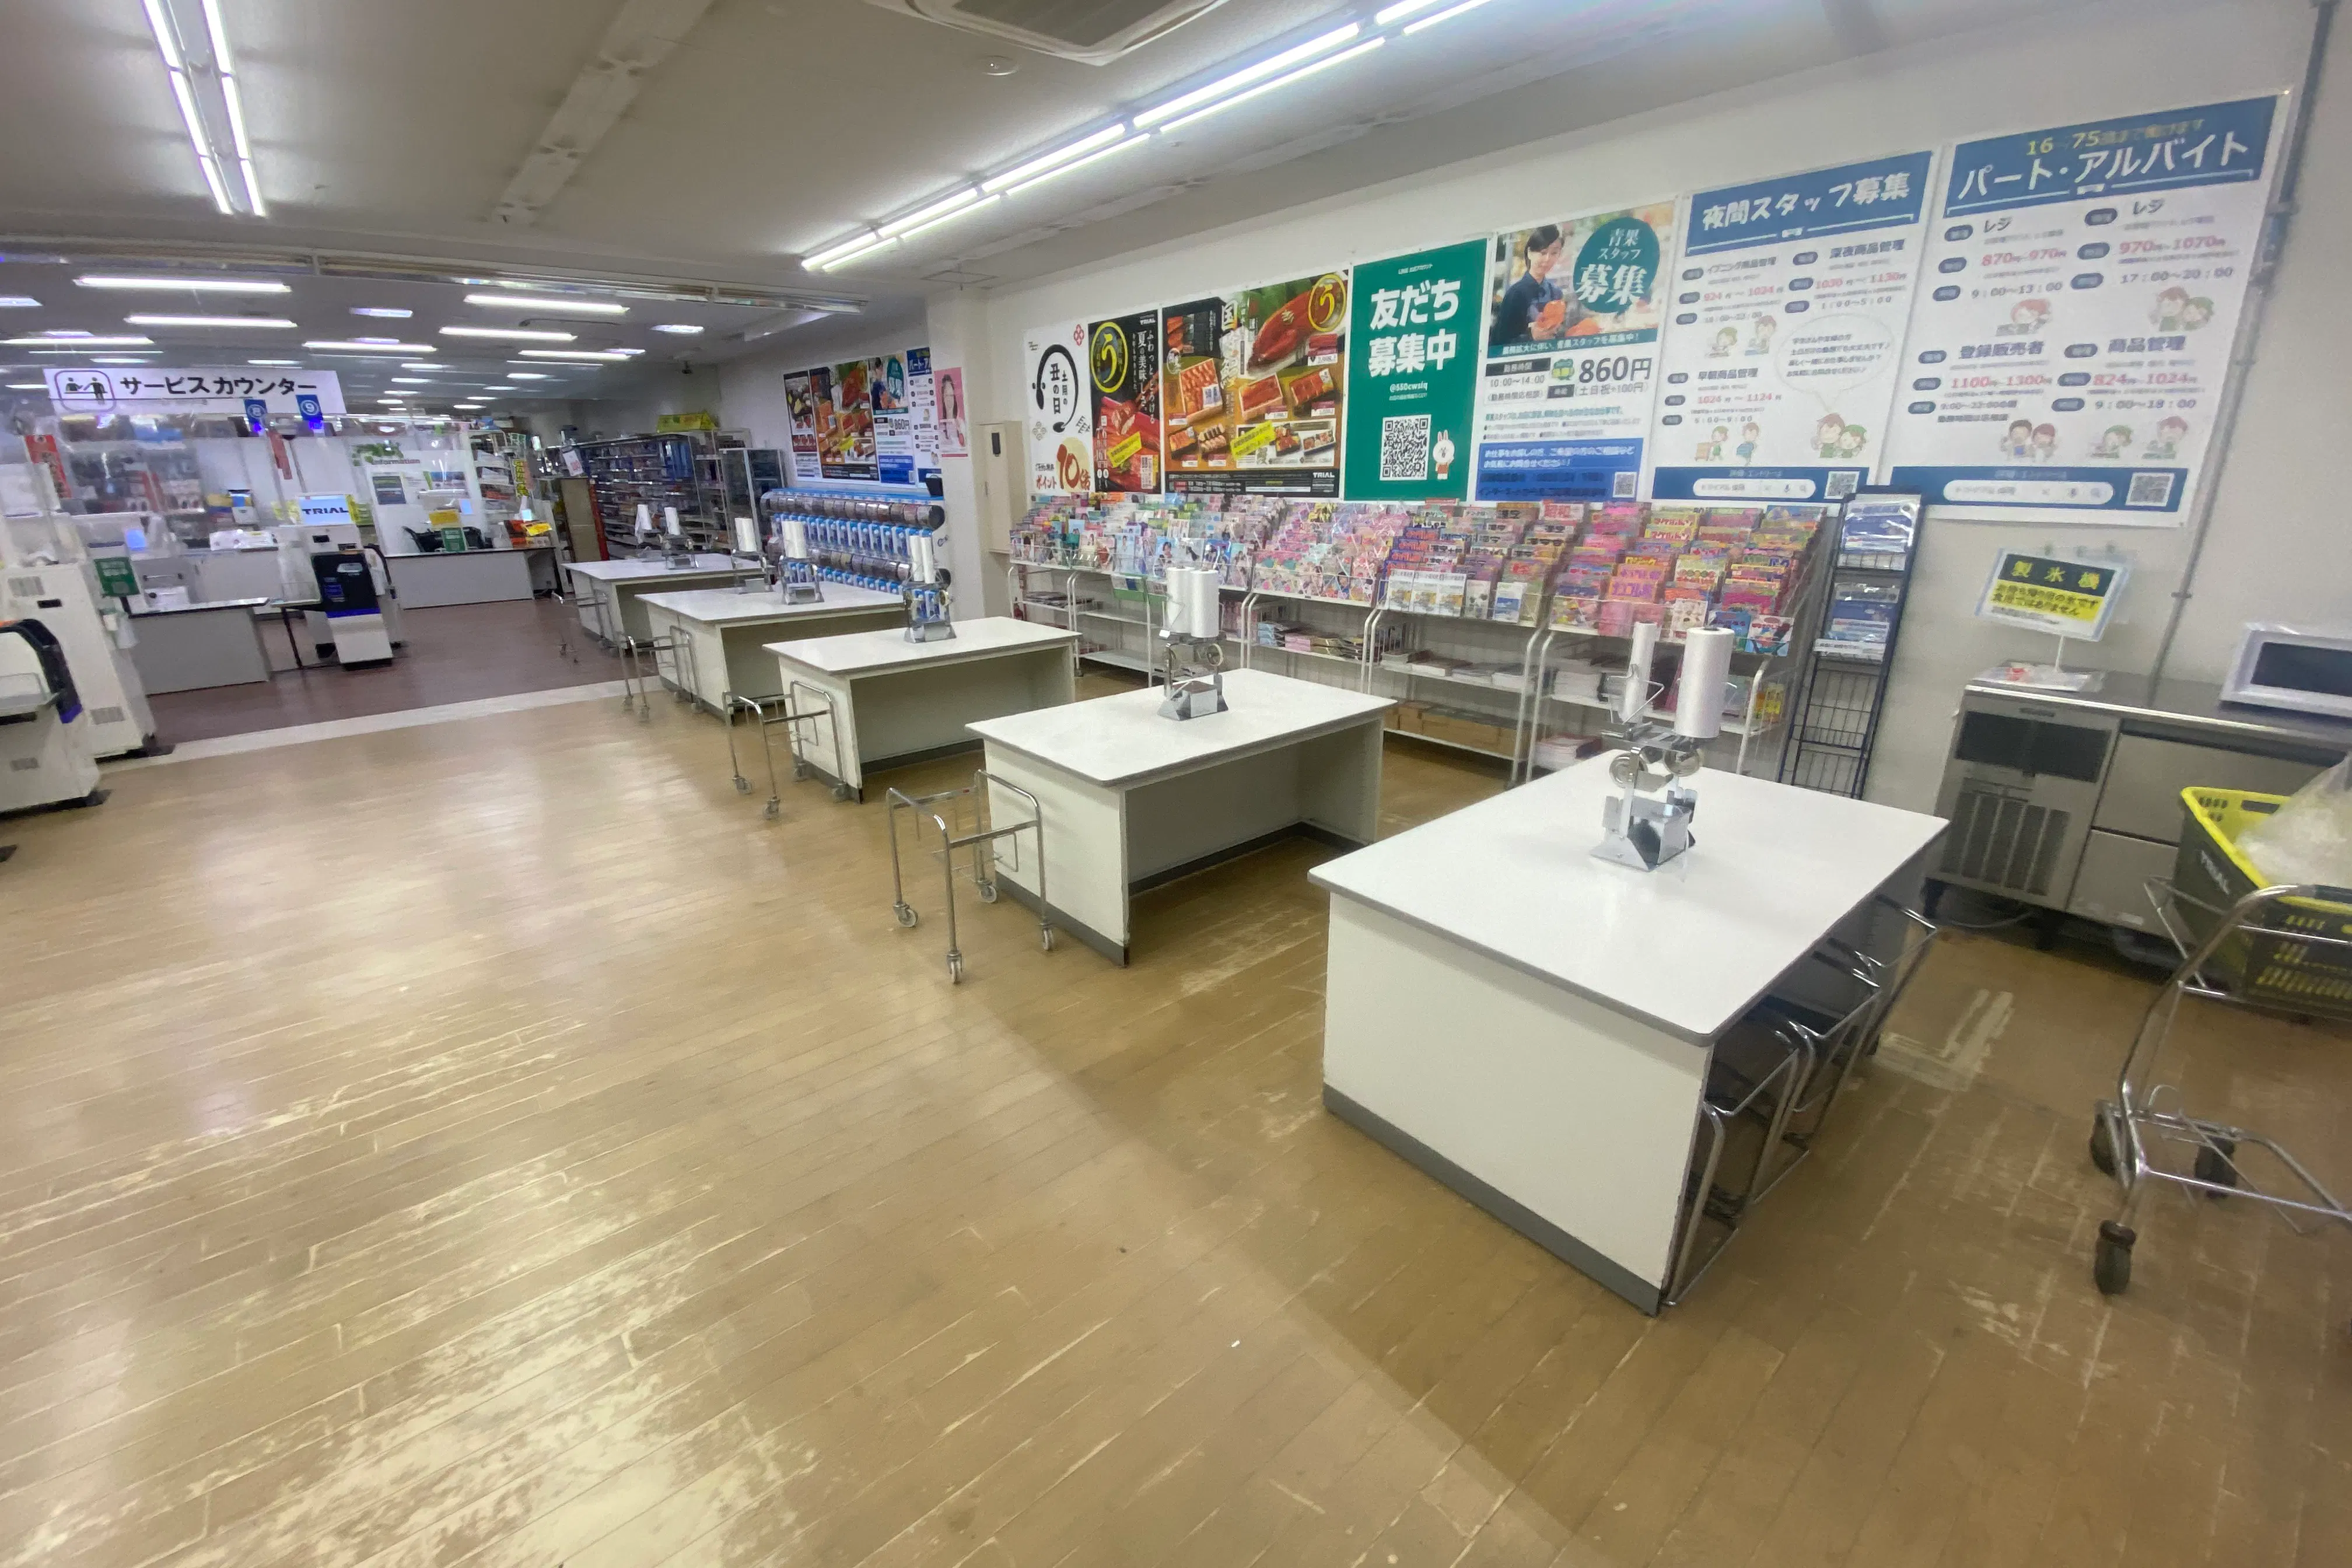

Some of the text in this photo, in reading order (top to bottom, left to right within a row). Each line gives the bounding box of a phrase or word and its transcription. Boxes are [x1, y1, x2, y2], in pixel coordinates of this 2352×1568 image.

[1958, 131, 2249, 200] パート・アルバイト
[1702, 172, 1911, 231] 夜間スタッフ募集
[2132, 198, 2165, 216] レジ
[1609, 228, 1639, 247] 青果
[1984, 216, 2013, 233] レジ
[1597, 247, 1642, 261] スタッフ
[1320, 284, 1335, 324] う
[1370, 279, 1461, 330] 友だち
[1575, 264, 1647, 305] 募集
[1101, 333, 1117, 383] う
[1368, 328, 1457, 377] 募集中
[1578, 356, 1653, 383] 860円
[120, 377, 317, 395] サービスカウンター
[1050, 363, 1060, 414] 丑の日
[302, 507, 349, 515] TRIAL
